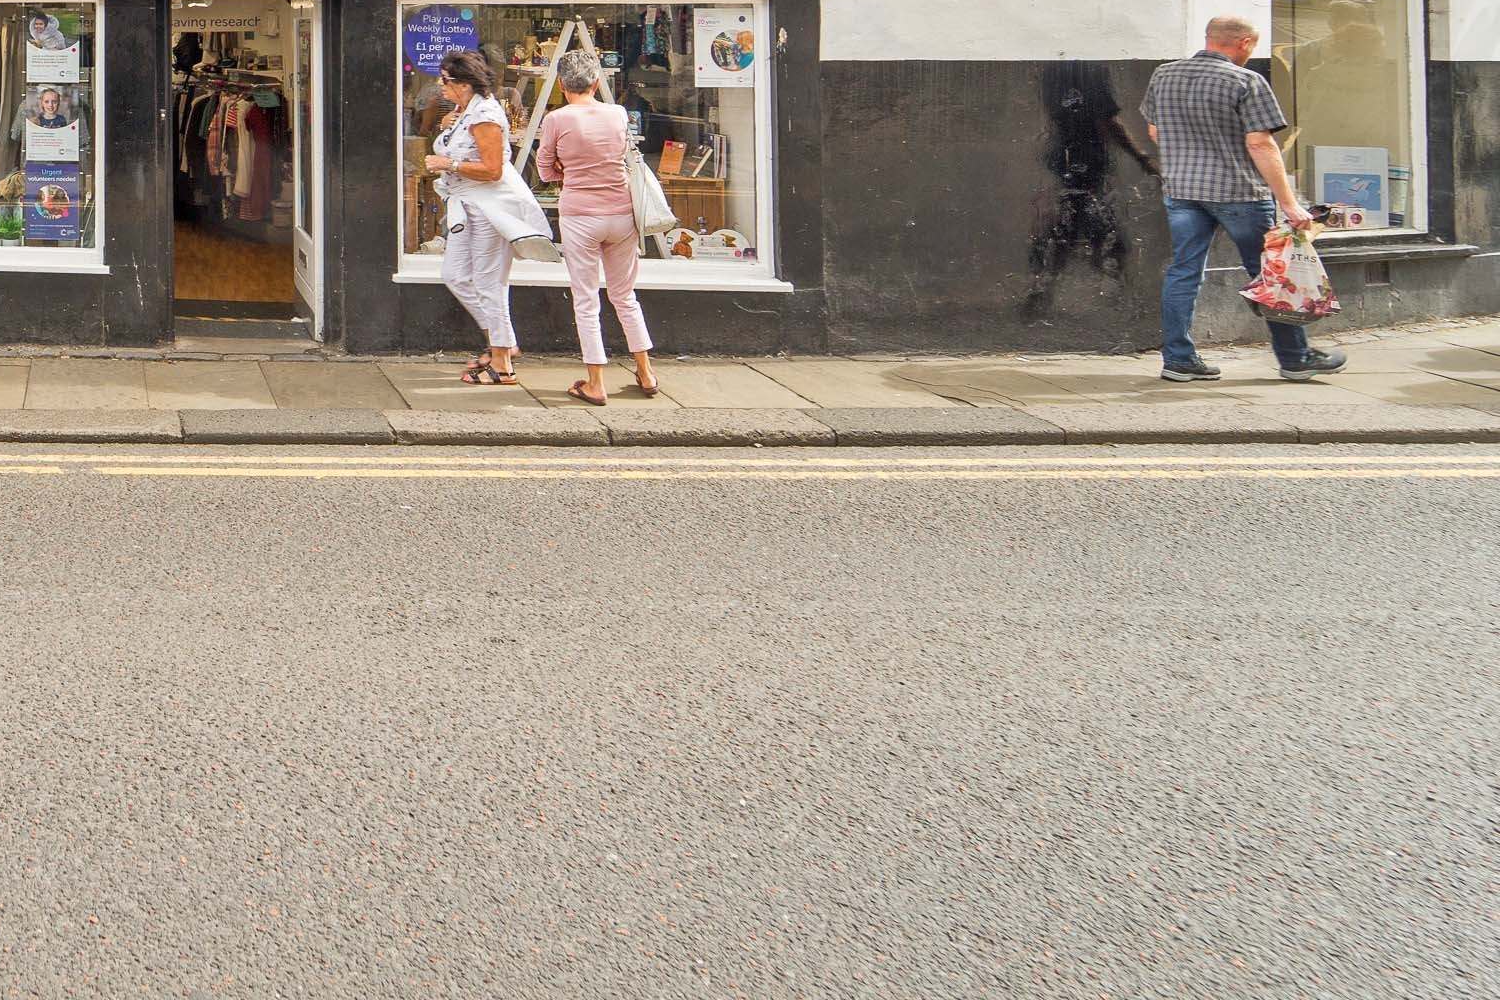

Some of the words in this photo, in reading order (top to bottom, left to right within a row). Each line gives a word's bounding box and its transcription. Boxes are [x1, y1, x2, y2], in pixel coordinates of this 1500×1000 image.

[209, 15, 261, 27] research
[423, 14, 442, 24] Play
[443, 16, 460, 24] our
[407, 23, 440, 34] Weekly
[442, 24, 474, 36] Lottery
[430, 34, 451, 43] here
[415, 42, 427, 51] £1
[428, 44, 444, 52] per
[446, 43, 466, 53] play
[419, 53, 435, 61] per
[41, 169, 62, 177] Urgent
